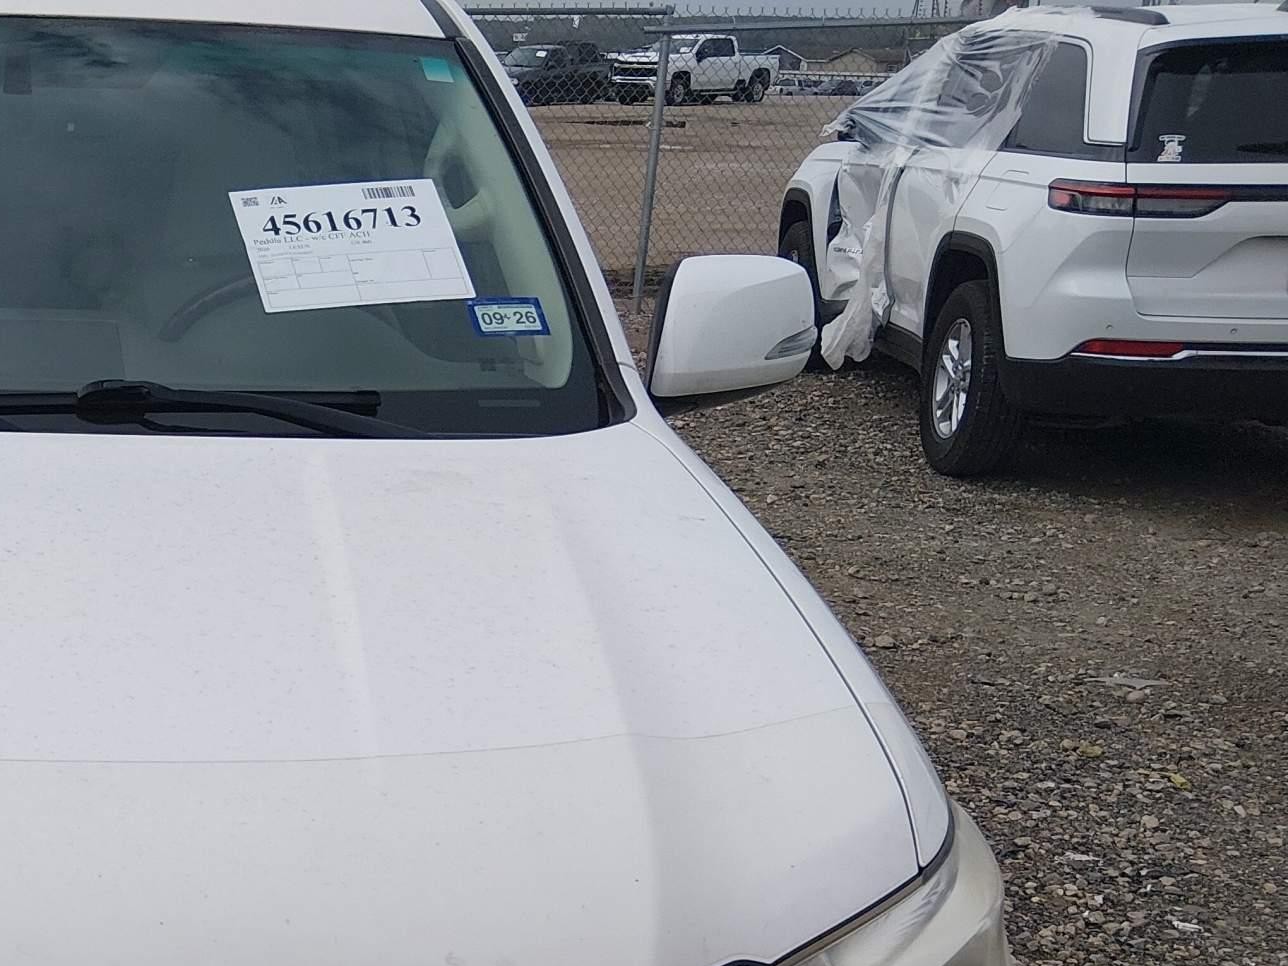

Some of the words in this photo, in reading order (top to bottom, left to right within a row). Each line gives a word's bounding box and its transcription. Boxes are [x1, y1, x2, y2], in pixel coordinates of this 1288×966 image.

[263, 205, 421, 236] 45616713
[481, 312, 505, 326] 09
[513, 311, 537, 325] 26
